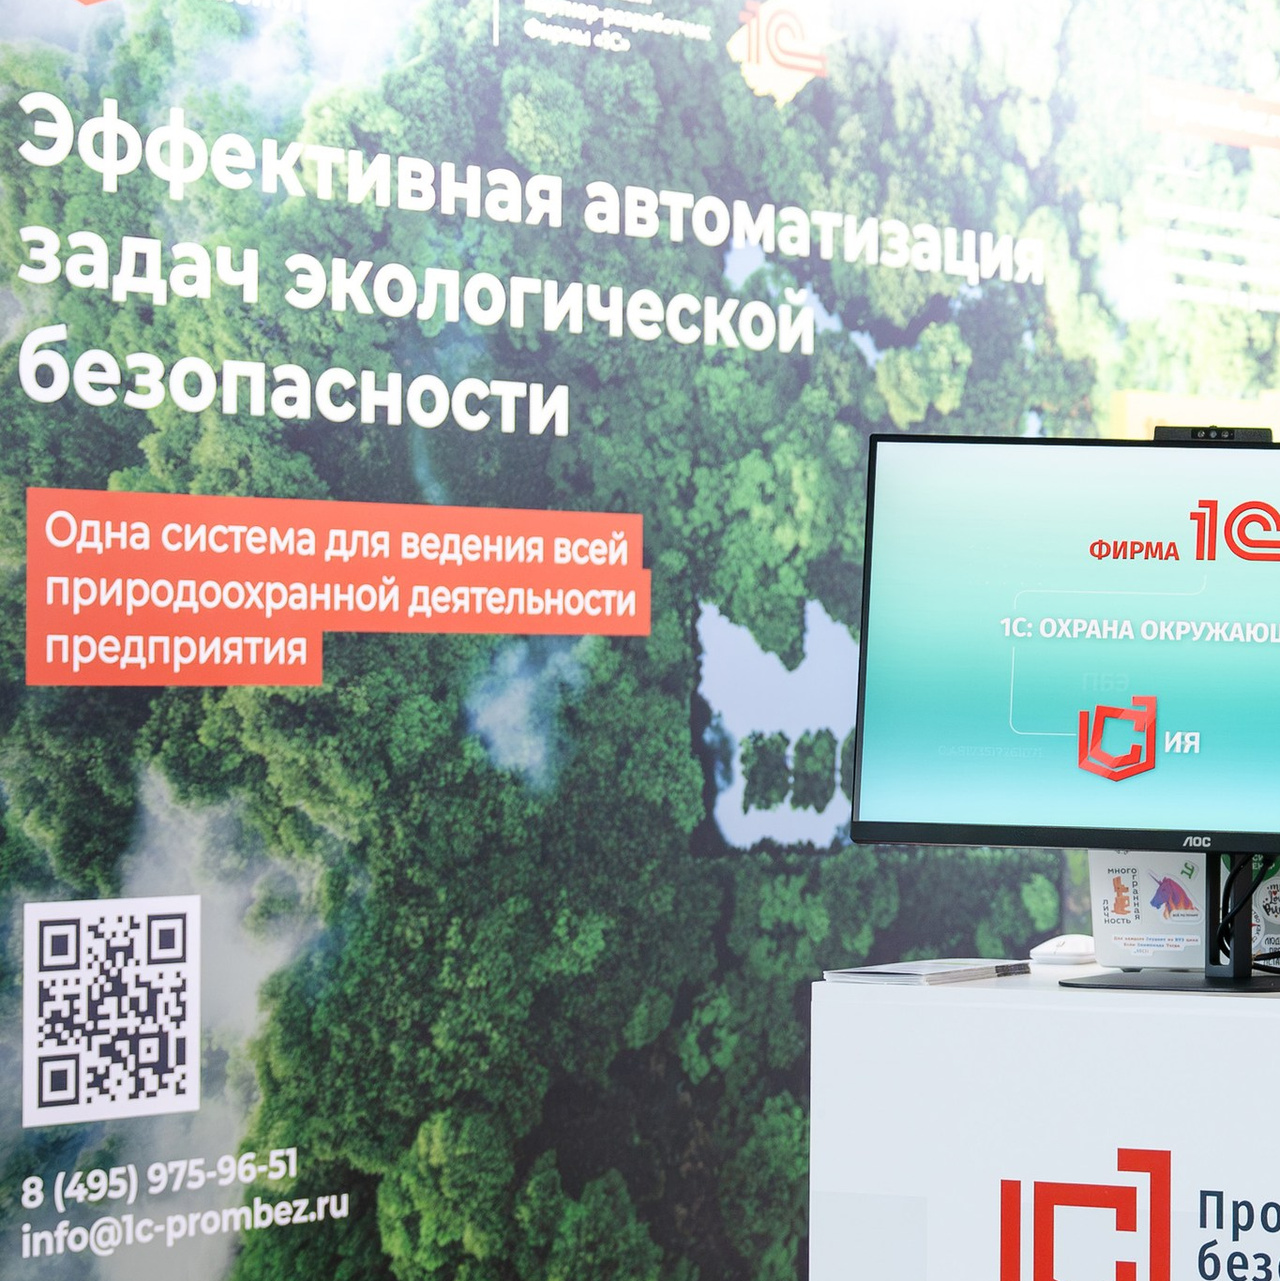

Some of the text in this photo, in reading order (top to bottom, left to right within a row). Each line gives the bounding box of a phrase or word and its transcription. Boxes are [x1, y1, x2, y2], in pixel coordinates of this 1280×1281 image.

[18, 91, 563, 228] Эффективная
[583, 179, 1045, 287] автоматизация
[17, 225, 815, 356] задач экологической
[17, 322, 570, 438] безопасности
[44, 510, 628, 568] Одна система для ведения всей
[1088, 539, 1181, 563] ФИРМА
[45, 573, 637, 620] природоохранной деятельности
[45, 630, 308, 674] предприятия
[998, 616, 1033, 638] 1С:
[1038, 617, 1135, 641] ОХРАНА
[1164, 730, 1201, 754] ИЯ
[1183, 835, 1212, 848] AOC
[21, 1146, 298, 1214] 8 (495) 975-96-51
[21, 1192, 350, 1260] info@1c-prombez.ru
